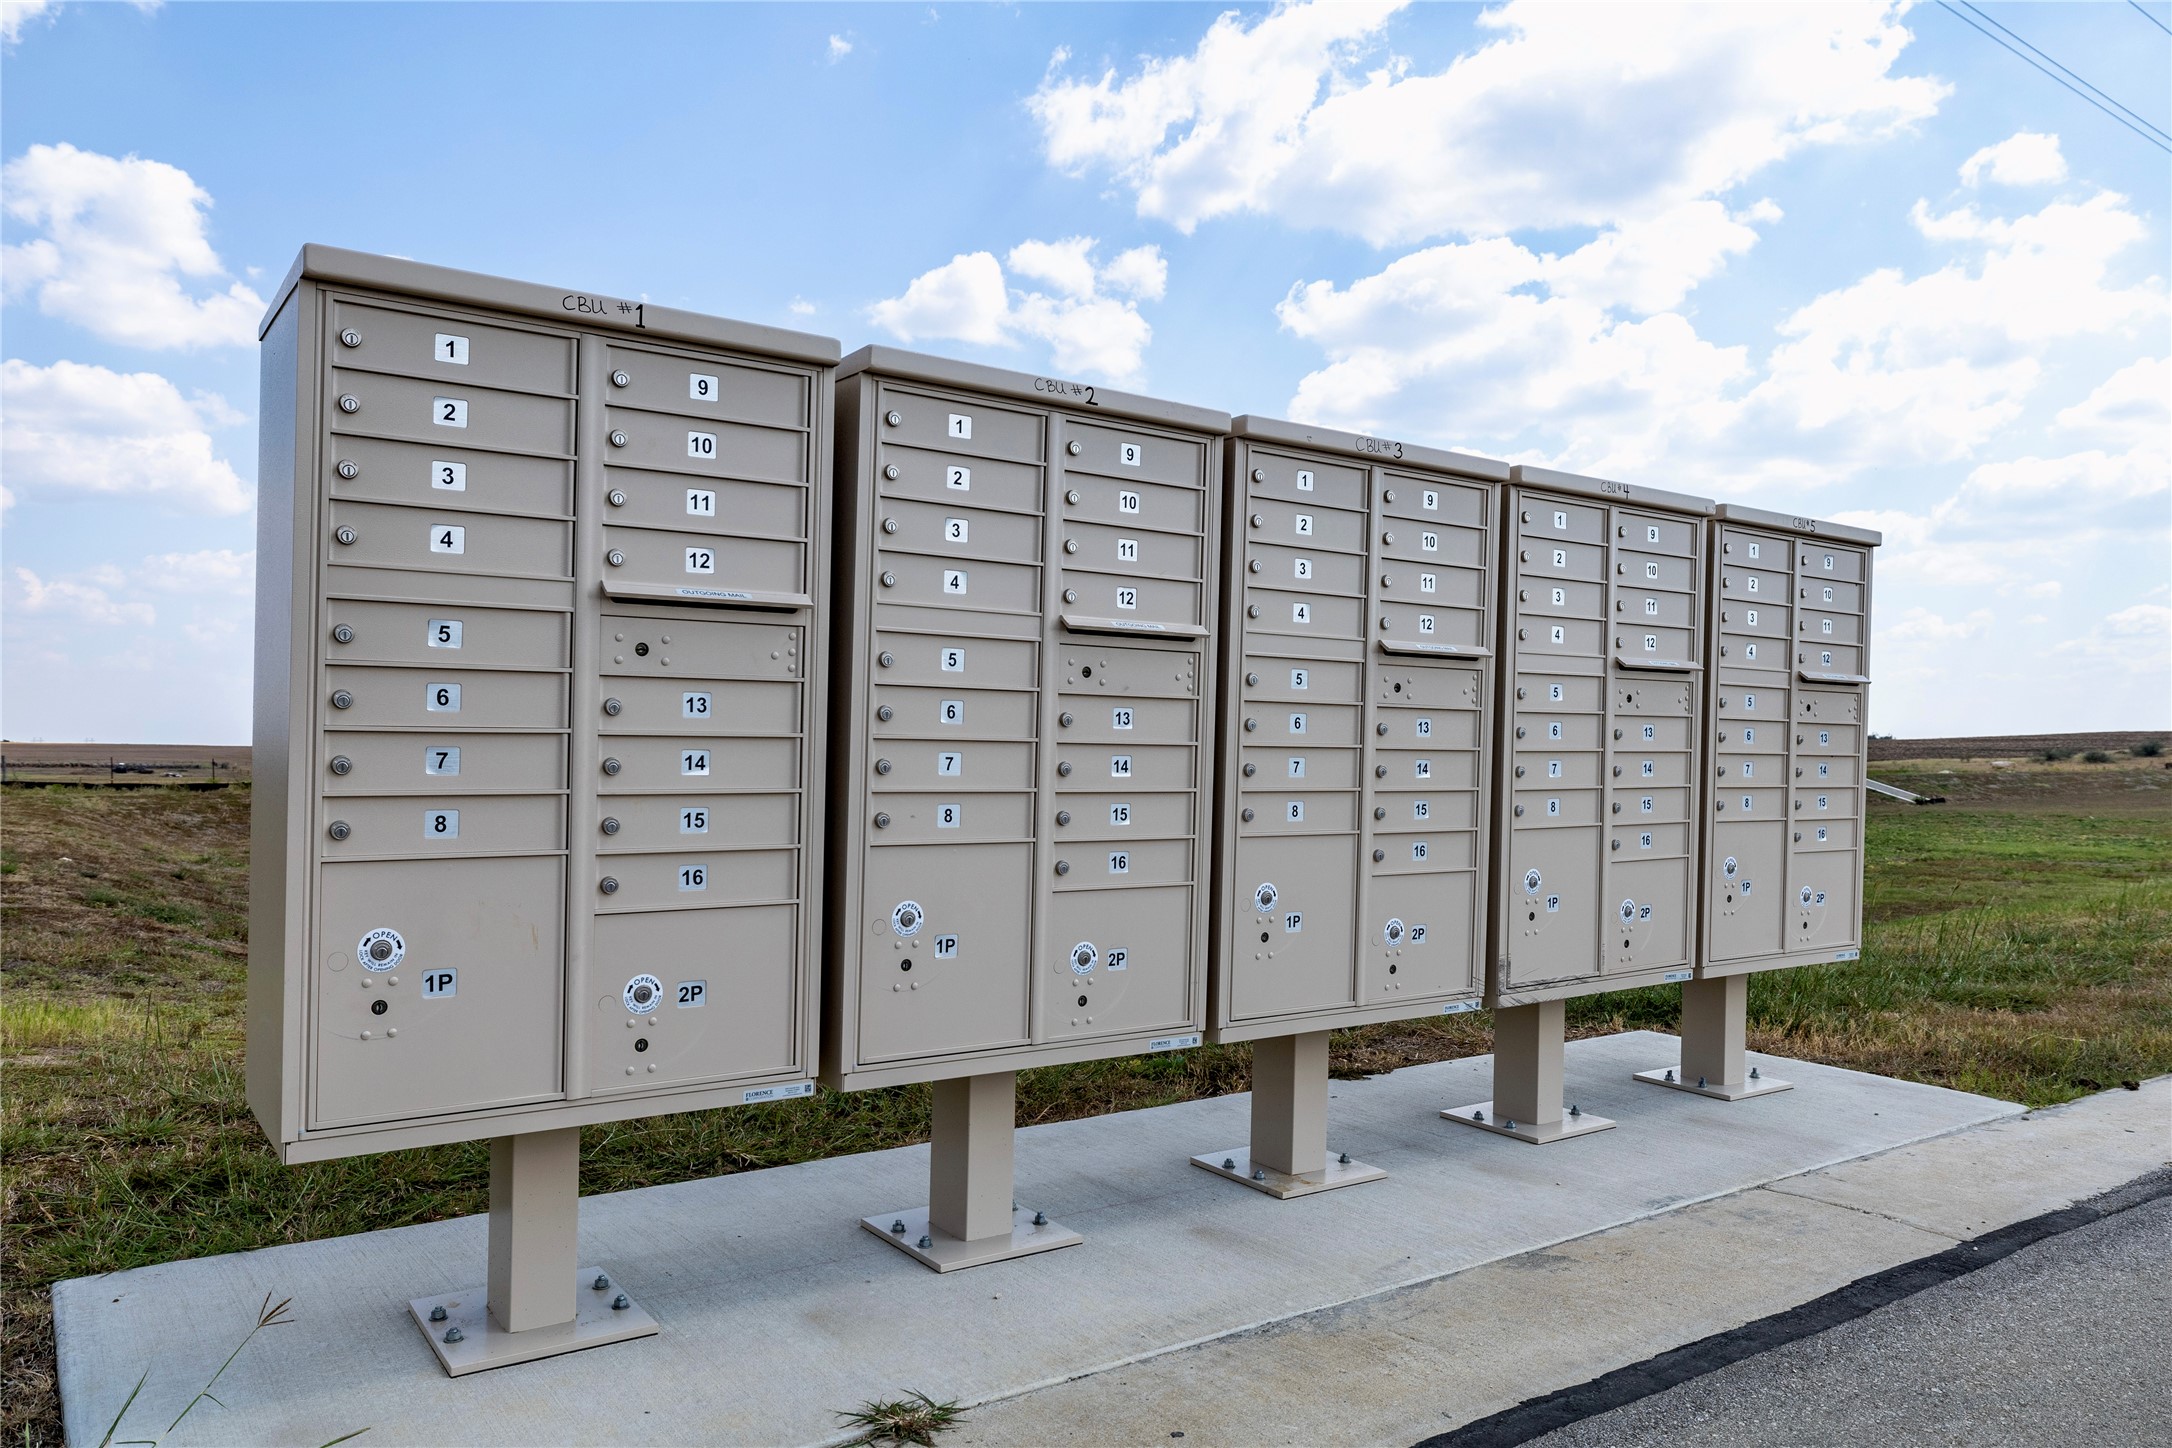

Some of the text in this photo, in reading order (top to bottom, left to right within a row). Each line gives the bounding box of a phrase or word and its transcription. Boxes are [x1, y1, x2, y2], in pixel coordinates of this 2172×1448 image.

[562, 295, 607, 315] CBU
[445, 340, 455, 359] 1
[697, 379, 709, 396] 9
[1034, 378, 1067, 395] CBU
[442, 403, 456, 422] 2
[955, 418, 963, 435] 1
[691, 436, 713, 455] 10
[1126, 447, 1135, 462] 9
[441, 466, 455, 485] 3
[953, 470, 963, 486] 2
[1301, 473, 1308, 488] 1
[690, 493, 710, 512] 11
[1121, 494, 1137, 510] 10
[1426, 493, 1434, 507] 9
[1300, 518, 1308, 532] 2
[1557, 514, 1563, 527] 1
[951, 522, 961, 539] 3
[1649, 528, 1656, 540] 9
[439, 530, 454, 549] 4
[1423, 535, 1436, 549] 10
[1119, 542, 1134, 558] 11
[688, 551, 711, 570] 12
[1556, 552, 1563, 565] 2
[1826, 557, 1832, 568] 9
[1299, 561, 1307, 576] 3
[1647, 564, 1657, 577] 10
[949, 574, 960, 590] 4
[1422, 576, 1433, 590] 11
[1750, 578, 1756, 590] 2
[681, 589, 727, 598] OUTGOING
[1118, 590, 1135, 606] 12
[1555, 590, 1562, 603] 3
[1824, 589, 1832, 600] 10
[1297, 606, 1305, 620] 4
[1646, 600, 1656, 612] 11
[1420, 617, 1433, 631] 12
[1749, 612, 1755, 624] 3
[437, 624, 451, 643] 5
[1823, 621, 1831, 632] 11
[1554, 628, 1561, 641] 4
[1645, 637, 1656, 649] 12
[1748, 646, 1754, 657] 4
[1822, 653, 1831, 664] 12
[947, 652, 958, 668] 5
[1295, 672, 1303, 686] 5
[436, 688, 450, 707] 6
[1552, 686, 1559, 699] 5
[685, 696, 708, 714] 13
[1747, 696, 1753, 708] 5
[946, 704, 956, 720] 6
[1115, 711, 1131, 726] 13
[1293, 716, 1302, 730] 6
[1417, 721, 1430, 734] 13
[1552, 724, 1559, 737] 6
[1643, 726, 1654, 738] 13
[1746, 730, 1752, 741] 6
[1819, 733, 1828, 744] 13
[435, 751, 449, 770] 7
[684, 754, 707, 771] 14
[944, 756, 955, 772] 7
[1113, 759, 1130, 774] 14
[1292, 760, 1301, 774] 7
[1416, 762, 1429, 775] 14
[1551, 762, 1558, 775] 7
[1643, 762, 1653, 774] 14
[1745, 763, 1751, 775] 7
[1819, 765, 1827, 775] 14
[1550, 800, 1557, 813] 8
[1642, 798, 1652, 811] 15
[1744, 797, 1750, 809] 8
[1818, 796, 1827, 808] 15
[943, 807, 953, 824] 8
[1112, 807, 1128, 822] 15
[1291, 804, 1299, 818] 8
[1415, 803, 1428, 816] 15
[434, 814, 447, 833] 8
[683, 811, 705, 829] 15
[1641, 834, 1651, 846] 16
[1817, 828, 1826, 839] 16
[1413, 844, 1426, 858] 16
[1110, 855, 1127, 870] 16
[681, 868, 704, 886] 16
[1741, 881, 1751, 893] 1P
[1547, 896, 1559, 909] 1P
[1815, 892, 1825, 904] 2P
[902, 904, 919, 912] OPEN
[1640, 906, 1651, 919] 2P
[1286, 914, 1301, 929] 1P
[372, 931, 398, 941] OPEN
[1411, 927, 1426, 941] 2P
[936, 938, 956, 954] 1P
[1107, 951, 1126, 967] 2P
[424, 973, 454, 993] 1P
[634, 977, 656, 985] OPEN
[678, 984, 704, 1004] 2P
[745, 1089, 773, 1098] FLORENCE
